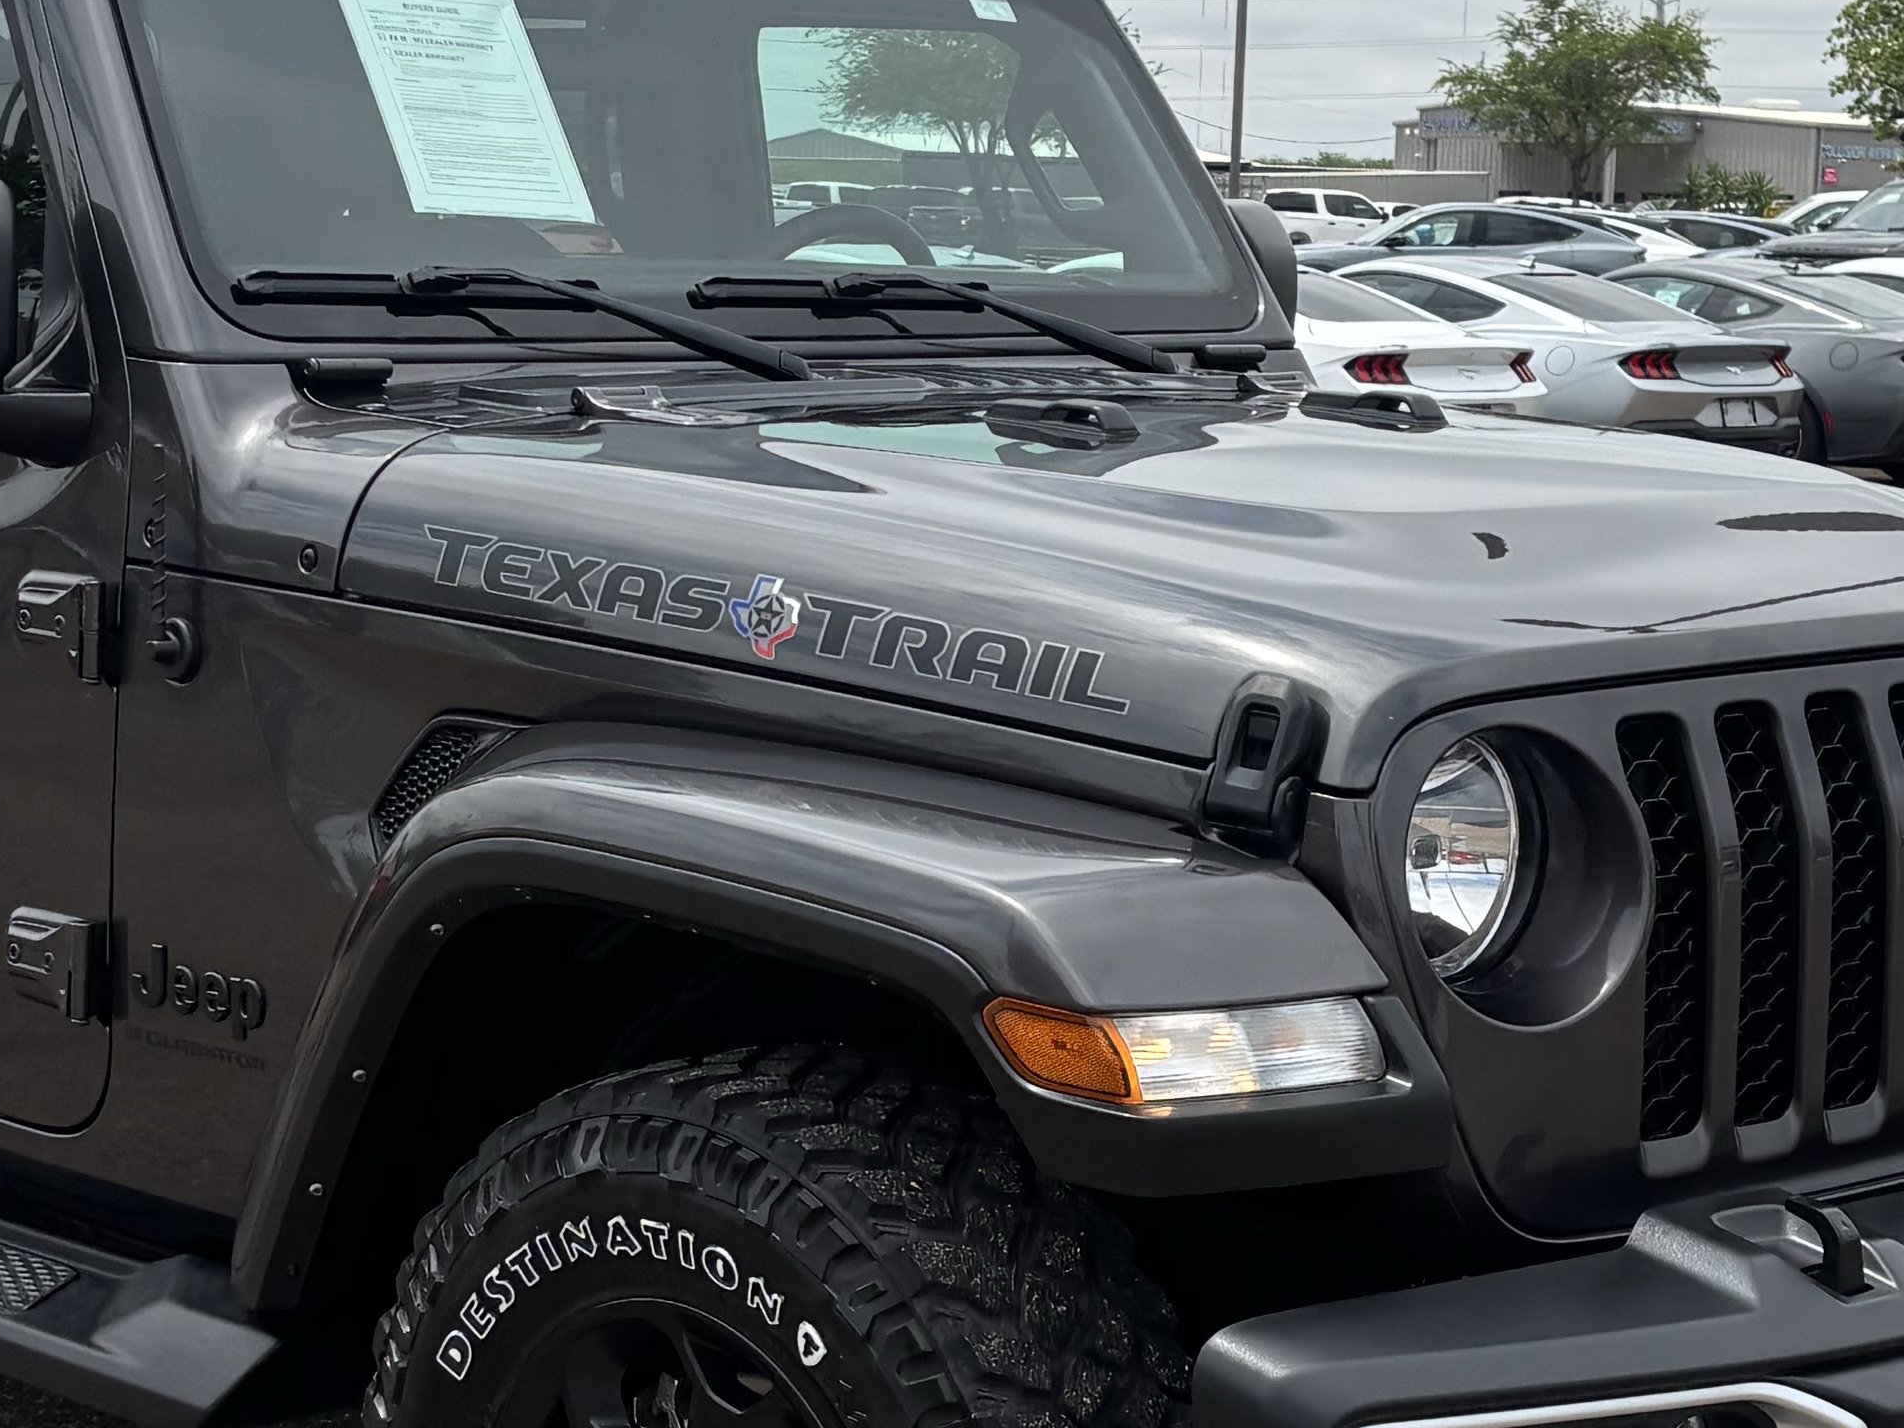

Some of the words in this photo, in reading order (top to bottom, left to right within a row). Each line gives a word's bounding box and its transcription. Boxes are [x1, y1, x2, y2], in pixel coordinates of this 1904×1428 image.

[423, 524, 731, 633] TEXAS
[803, 592, 1132, 716] TRAIL
[132, 943, 268, 1041] Jeep
[436, 1215, 785, 1381] DESTINATION
